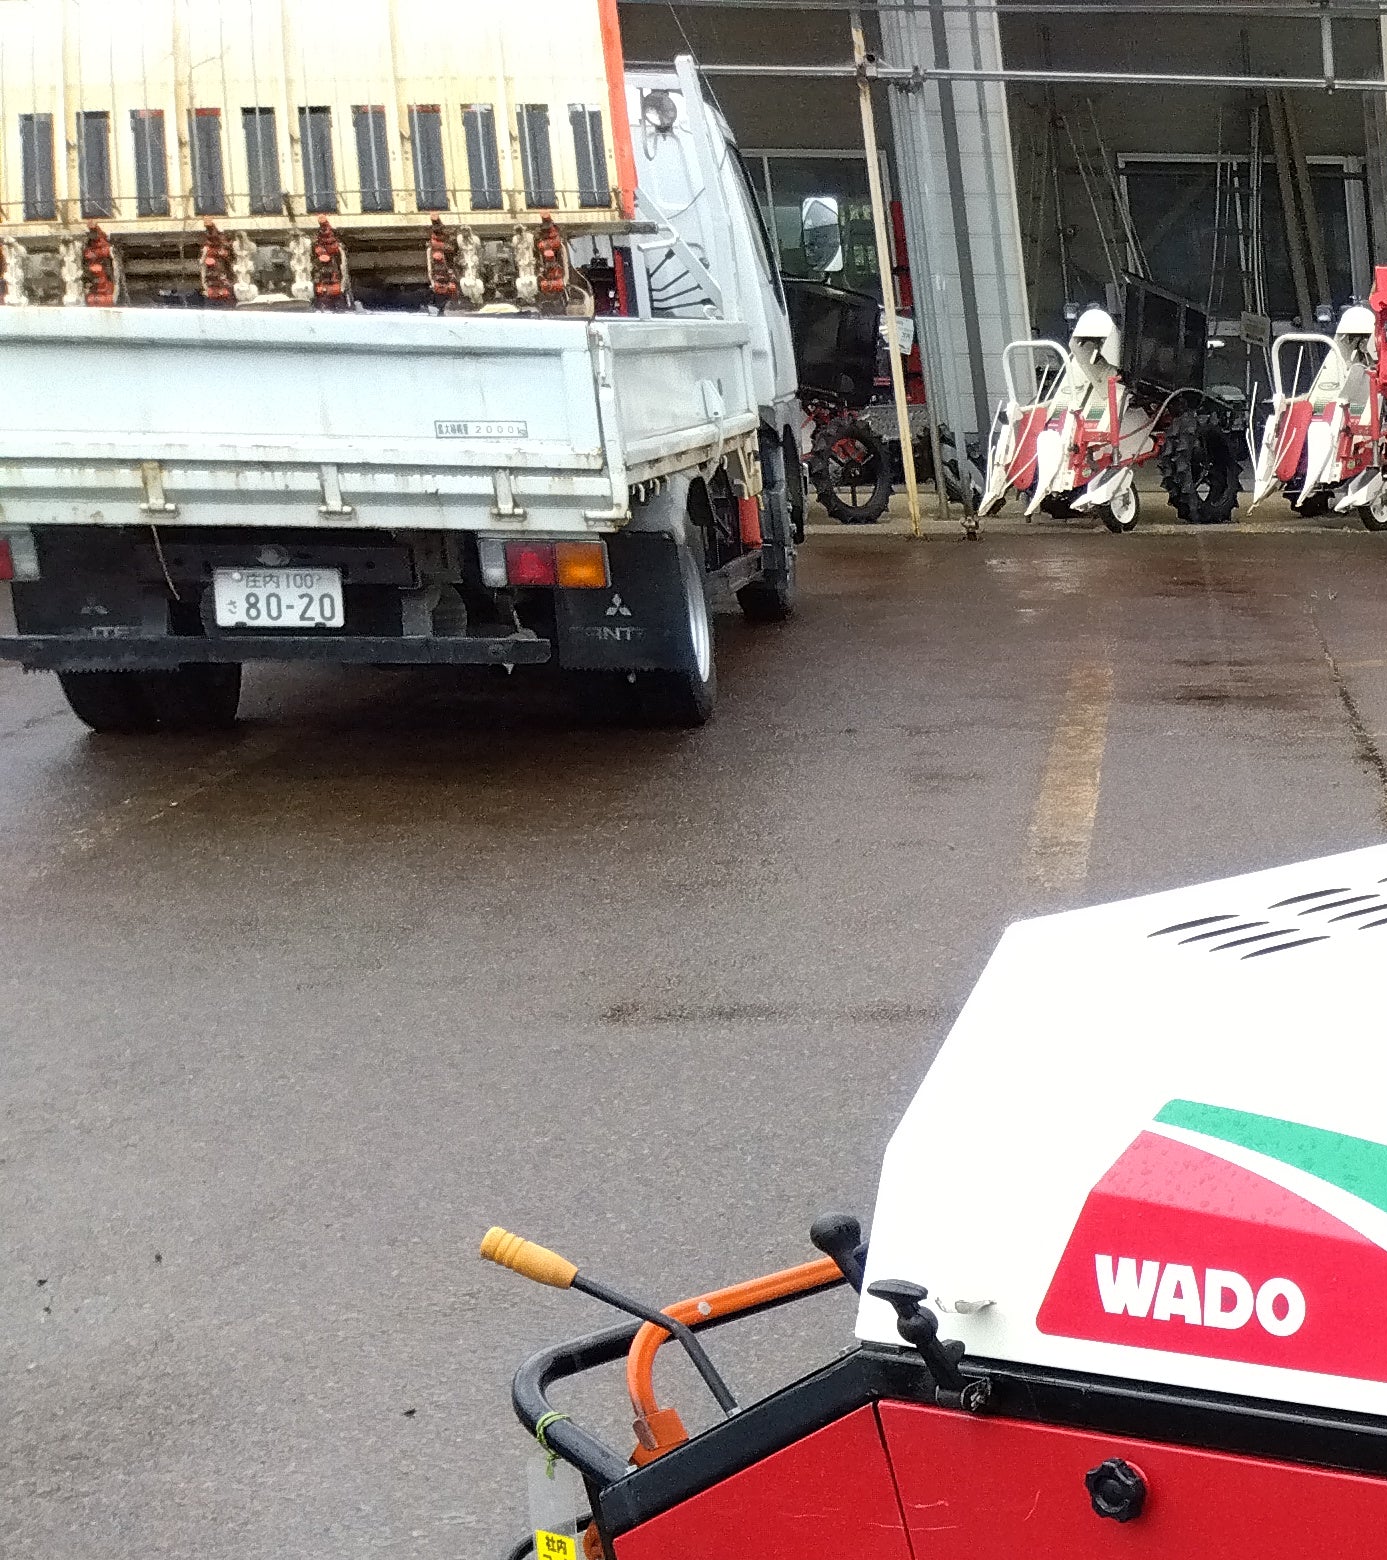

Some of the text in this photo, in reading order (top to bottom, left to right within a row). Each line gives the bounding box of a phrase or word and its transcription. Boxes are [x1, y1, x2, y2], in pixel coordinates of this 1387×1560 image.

[246, 572, 314, 589] 庄内 100
[245, 591, 336, 622] 80-20
[1094, 1253, 1306, 1337] WADO
